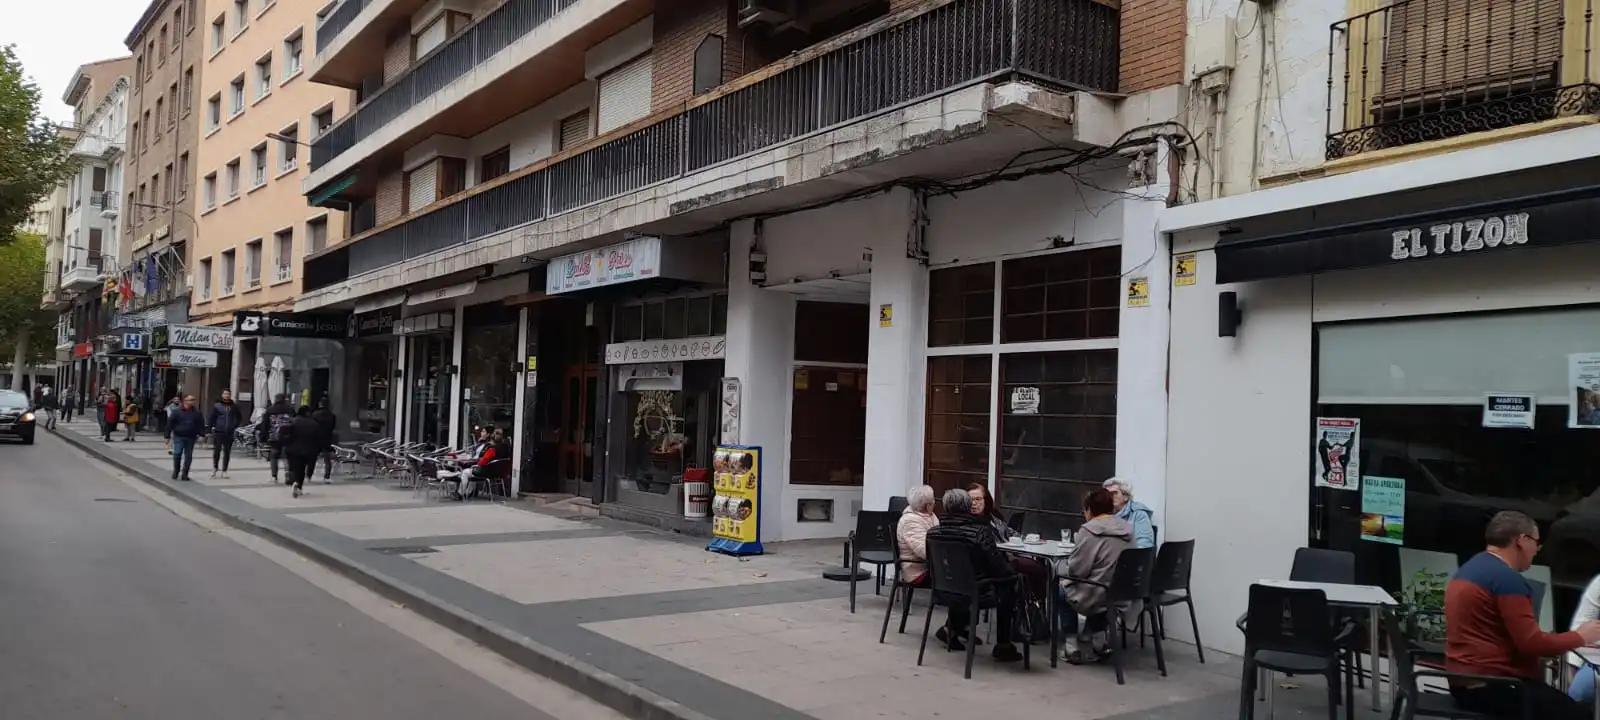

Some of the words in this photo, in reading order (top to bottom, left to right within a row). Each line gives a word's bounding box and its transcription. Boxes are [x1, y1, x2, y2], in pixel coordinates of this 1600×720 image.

[1391, 228, 1428, 259] EL
[1430, 212, 1529, 254] TIZON
[1018, 393, 1035, 401] LOCAL
